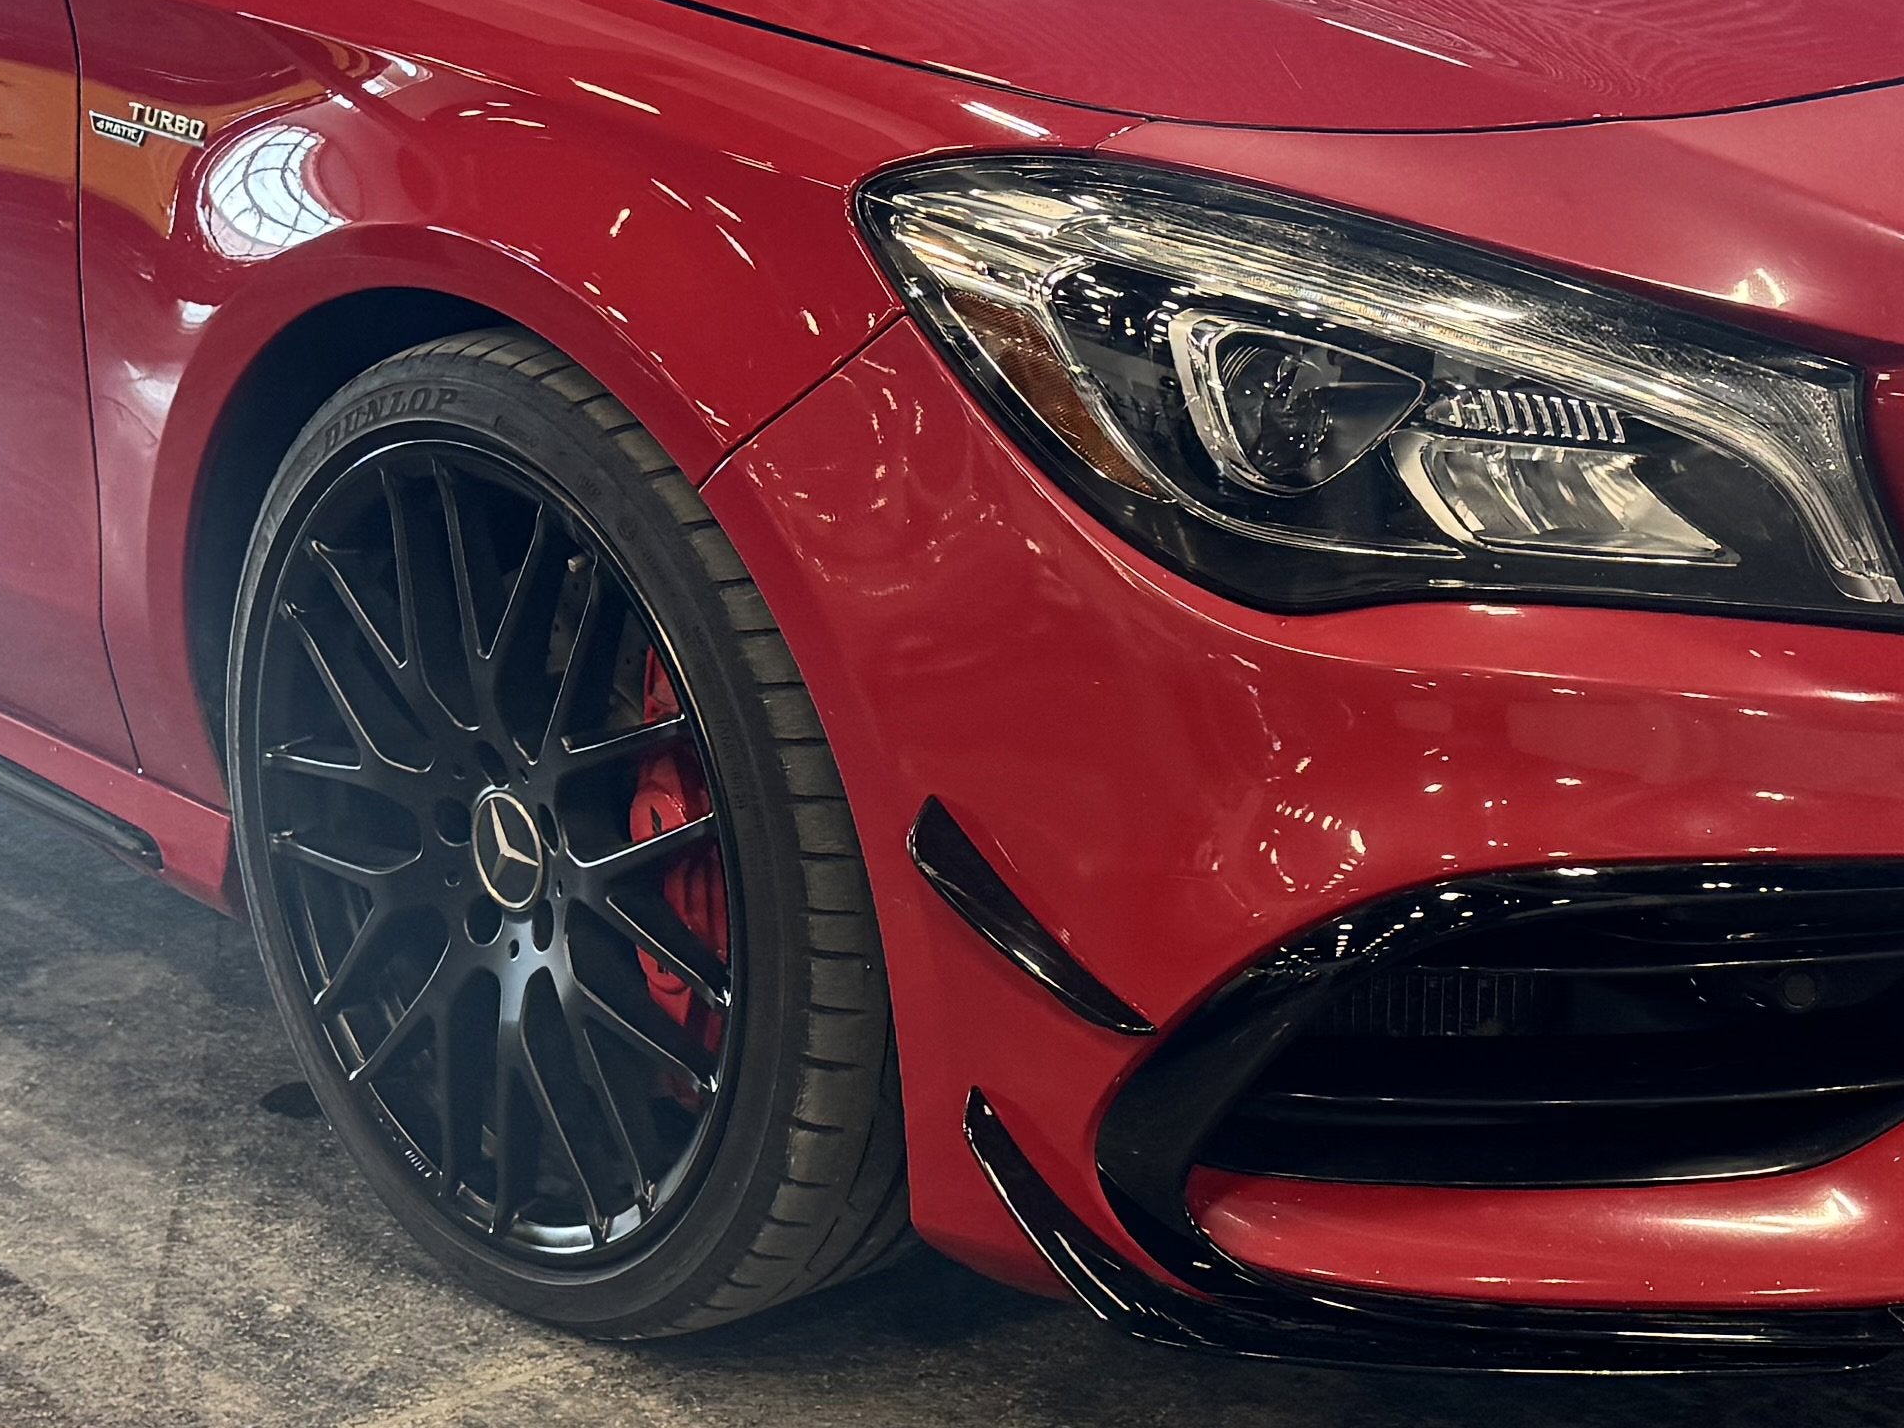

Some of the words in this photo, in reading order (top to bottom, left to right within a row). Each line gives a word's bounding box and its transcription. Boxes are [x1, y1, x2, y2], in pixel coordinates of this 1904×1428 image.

[95, 119, 138, 140] 4MATIC
[128, 101, 205, 140] TURBO
[323, 386, 459, 457] DUNLOP
